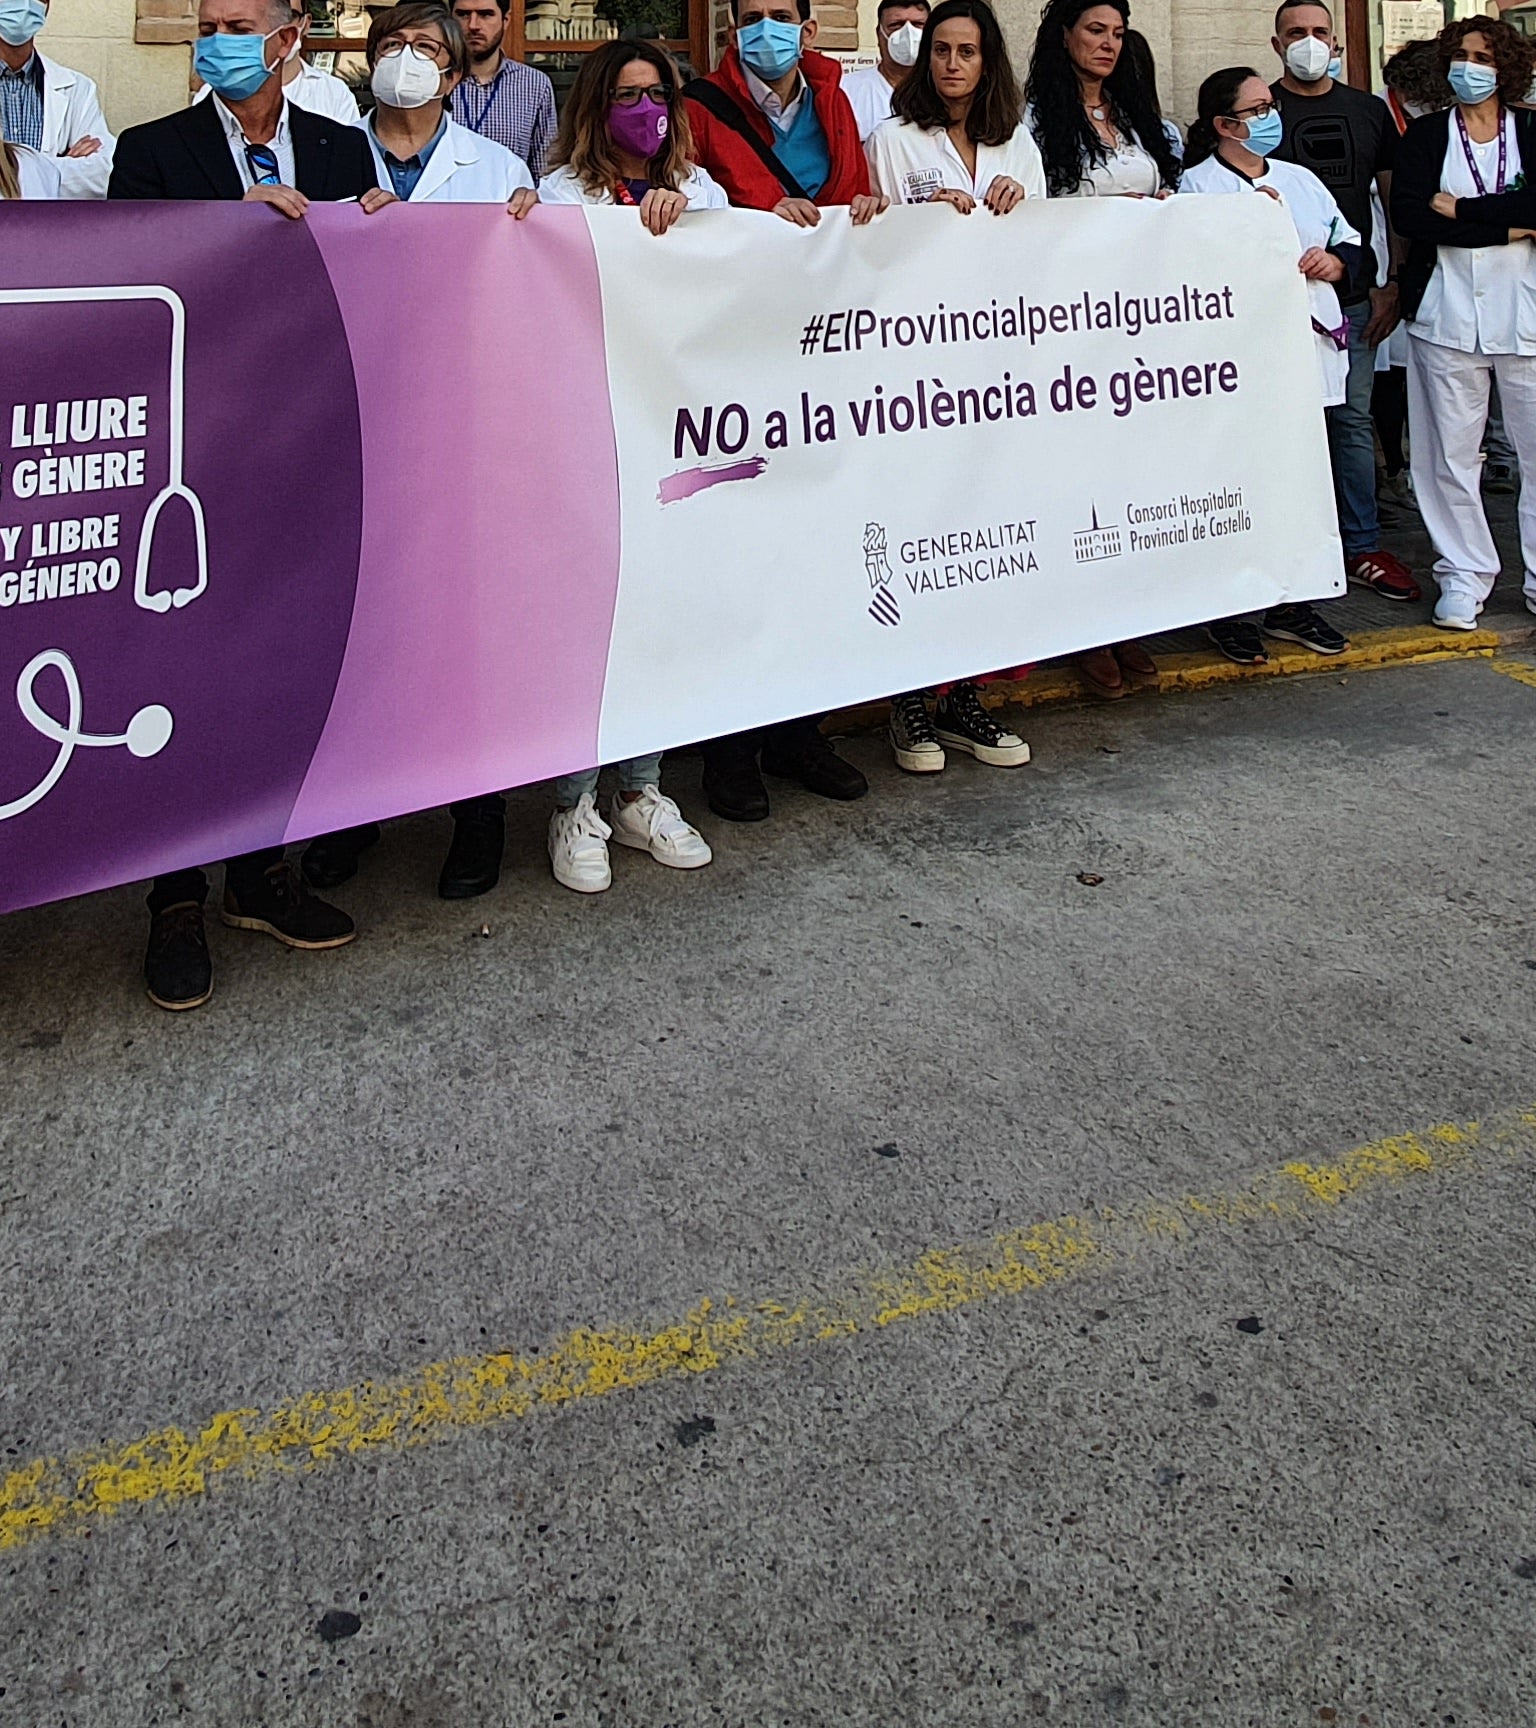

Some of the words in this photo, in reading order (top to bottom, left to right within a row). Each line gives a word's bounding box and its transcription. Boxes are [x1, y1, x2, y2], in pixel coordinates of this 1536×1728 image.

[799, 283, 1235, 356] #ElProvincialperlaIgualtat
[11, 395, 148, 448] LLIURE
[673, 402, 750, 459] NO
[764, 409, 789, 450] a
[800, 391, 837, 445] la
[848, 371, 1038, 437] violència
[1049, 364, 1098, 413] de
[1109, 356, 1239, 418] gènere
[12, 447, 145, 499] GÈNERE
[1126, 496, 1178, 525] Consorci
[1179, 485, 1243, 518] Hospitalari
[0, 525, 23, 562] Y
[31, 514, 120, 558] LIBRE
[900, 519, 1037, 564] GENERALITAT
[1129, 519, 1189, 552] Provincial
[1192, 517, 1206, 541] de
[1209, 509, 1252, 538] Castelló
[904, 550, 1040, 595] VALENCIANA
